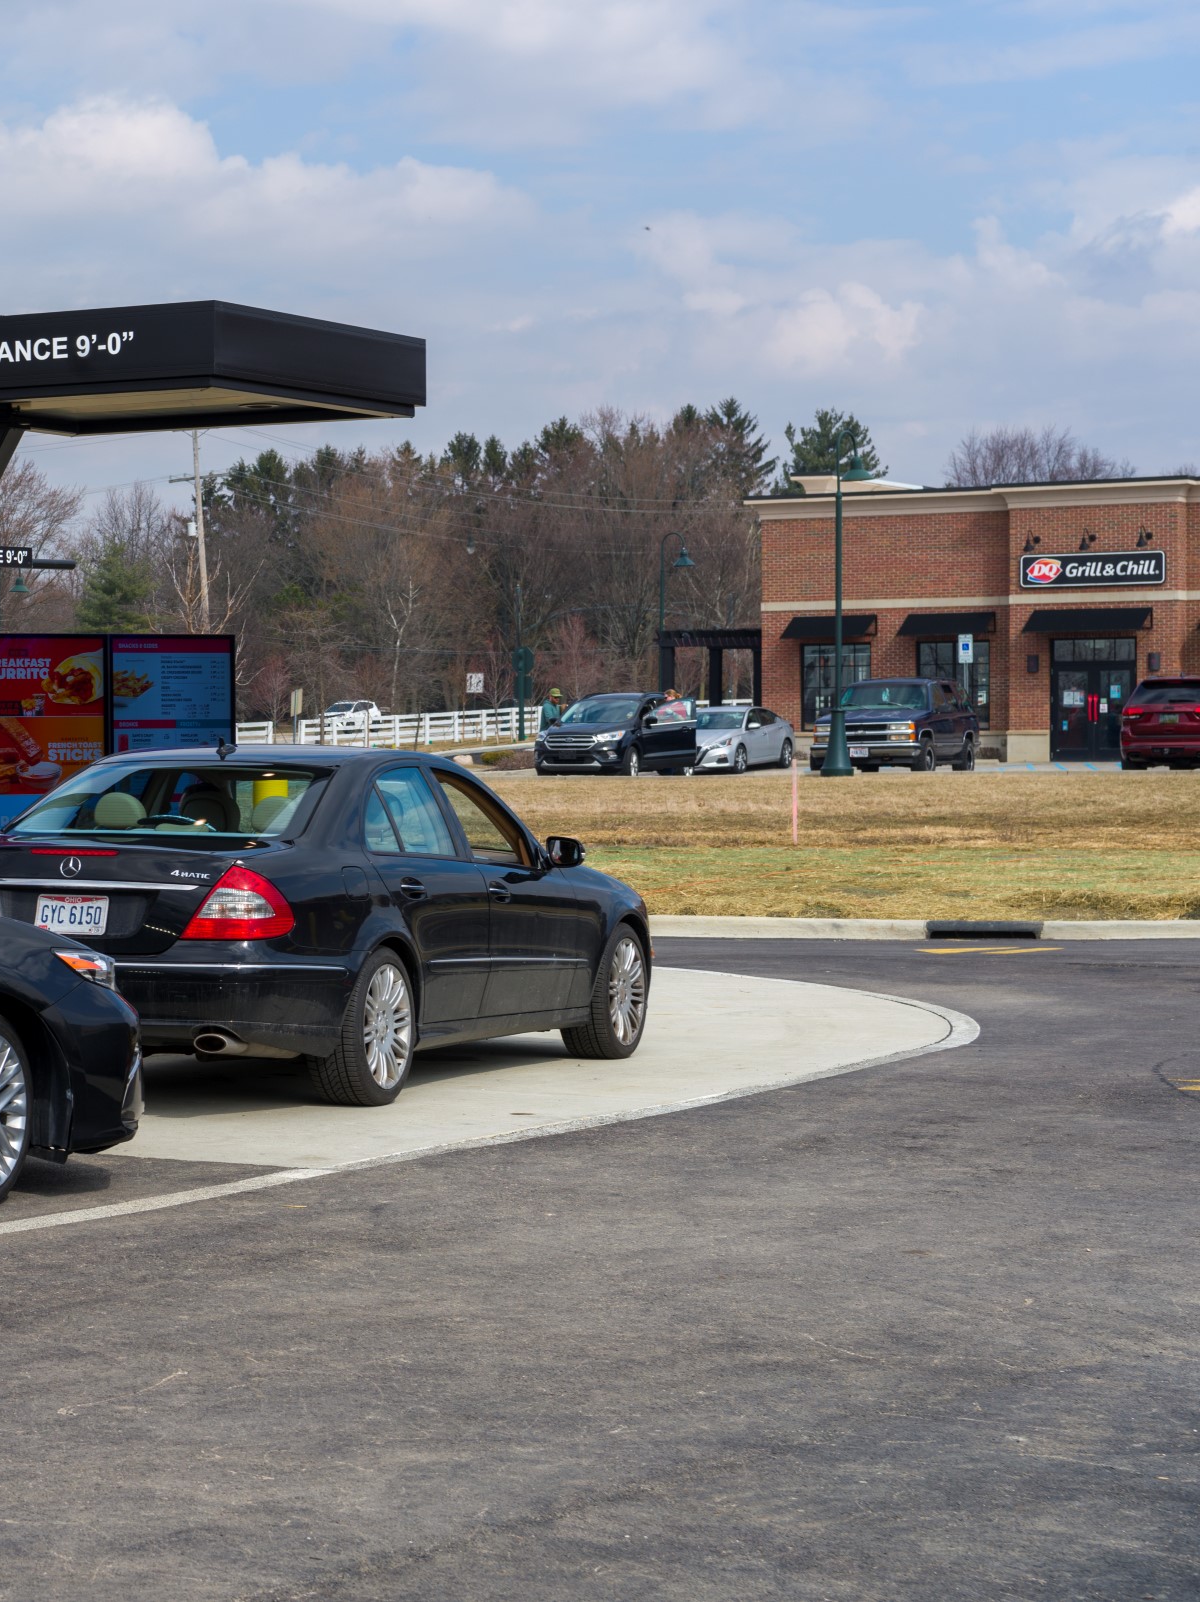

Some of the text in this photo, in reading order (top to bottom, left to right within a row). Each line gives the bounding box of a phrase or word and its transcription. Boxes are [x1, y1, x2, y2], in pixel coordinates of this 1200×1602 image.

[75, 331, 134, 358] 9'-0"
[1033, 564, 1057, 578] DQ
[48, 749, 103, 761] STICKS
[64, 896, 83, 904] OHIO
[40, 904, 102, 925] GYC 6150
